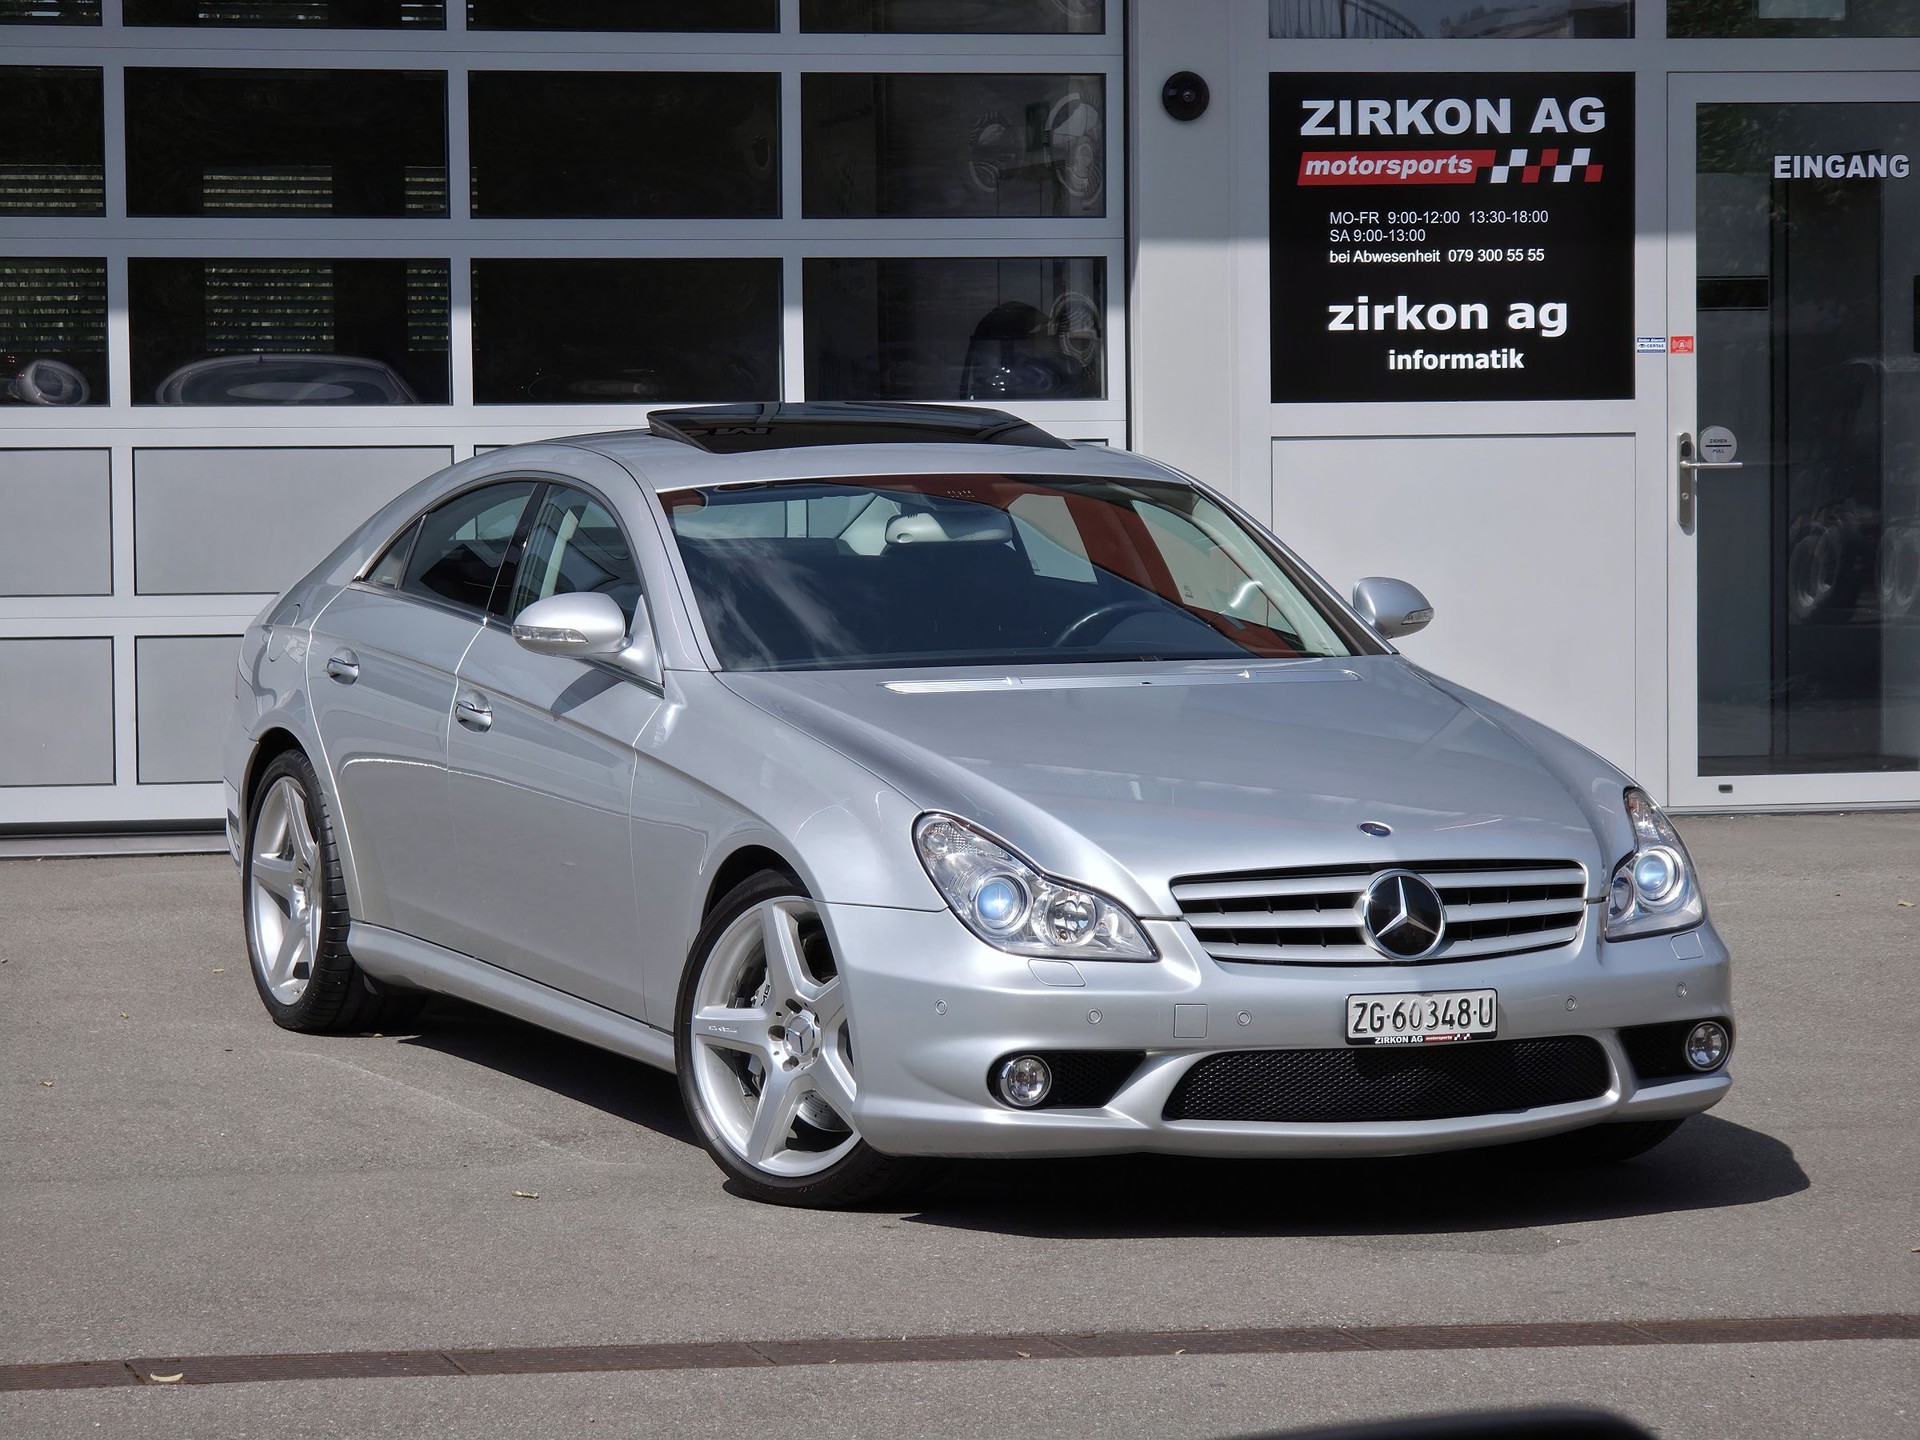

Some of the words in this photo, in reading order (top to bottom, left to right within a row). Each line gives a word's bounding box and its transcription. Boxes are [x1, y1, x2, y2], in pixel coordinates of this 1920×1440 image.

[1301, 99, 1511, 135] ZIRKON
[1530, 97, 1605, 133] AG
[1305, 154, 1473, 180] motorsports
[1774, 155, 1910, 179] EINGANG
[1329, 211, 1379, 225] MO-FR
[1388, 211, 1461, 225] 9:00-12:00
[1470, 210, 1549, 224] 13:30-18:00
[1329, 229, 1351, 243] SA
[1353, 229, 1426, 243] 9:00-13:00
[1329, 249, 1350, 264] bei
[1352, 249, 1441, 264] Abwesenheit
[1447, 249, 1474, 263] 079
[1478, 249, 1504, 263] 300
[1507, 248, 1524, 262] 55
[1527, 248, 1545, 262] 55
[1328, 296, 1489, 331] zirkon
[1508, 303, 1568, 338] ag
[1388, 348, 1525, 371] informatik
[1374, 1036, 1409, 1044] ZIRKON
[1410, 1035, 1424, 1043] AG
